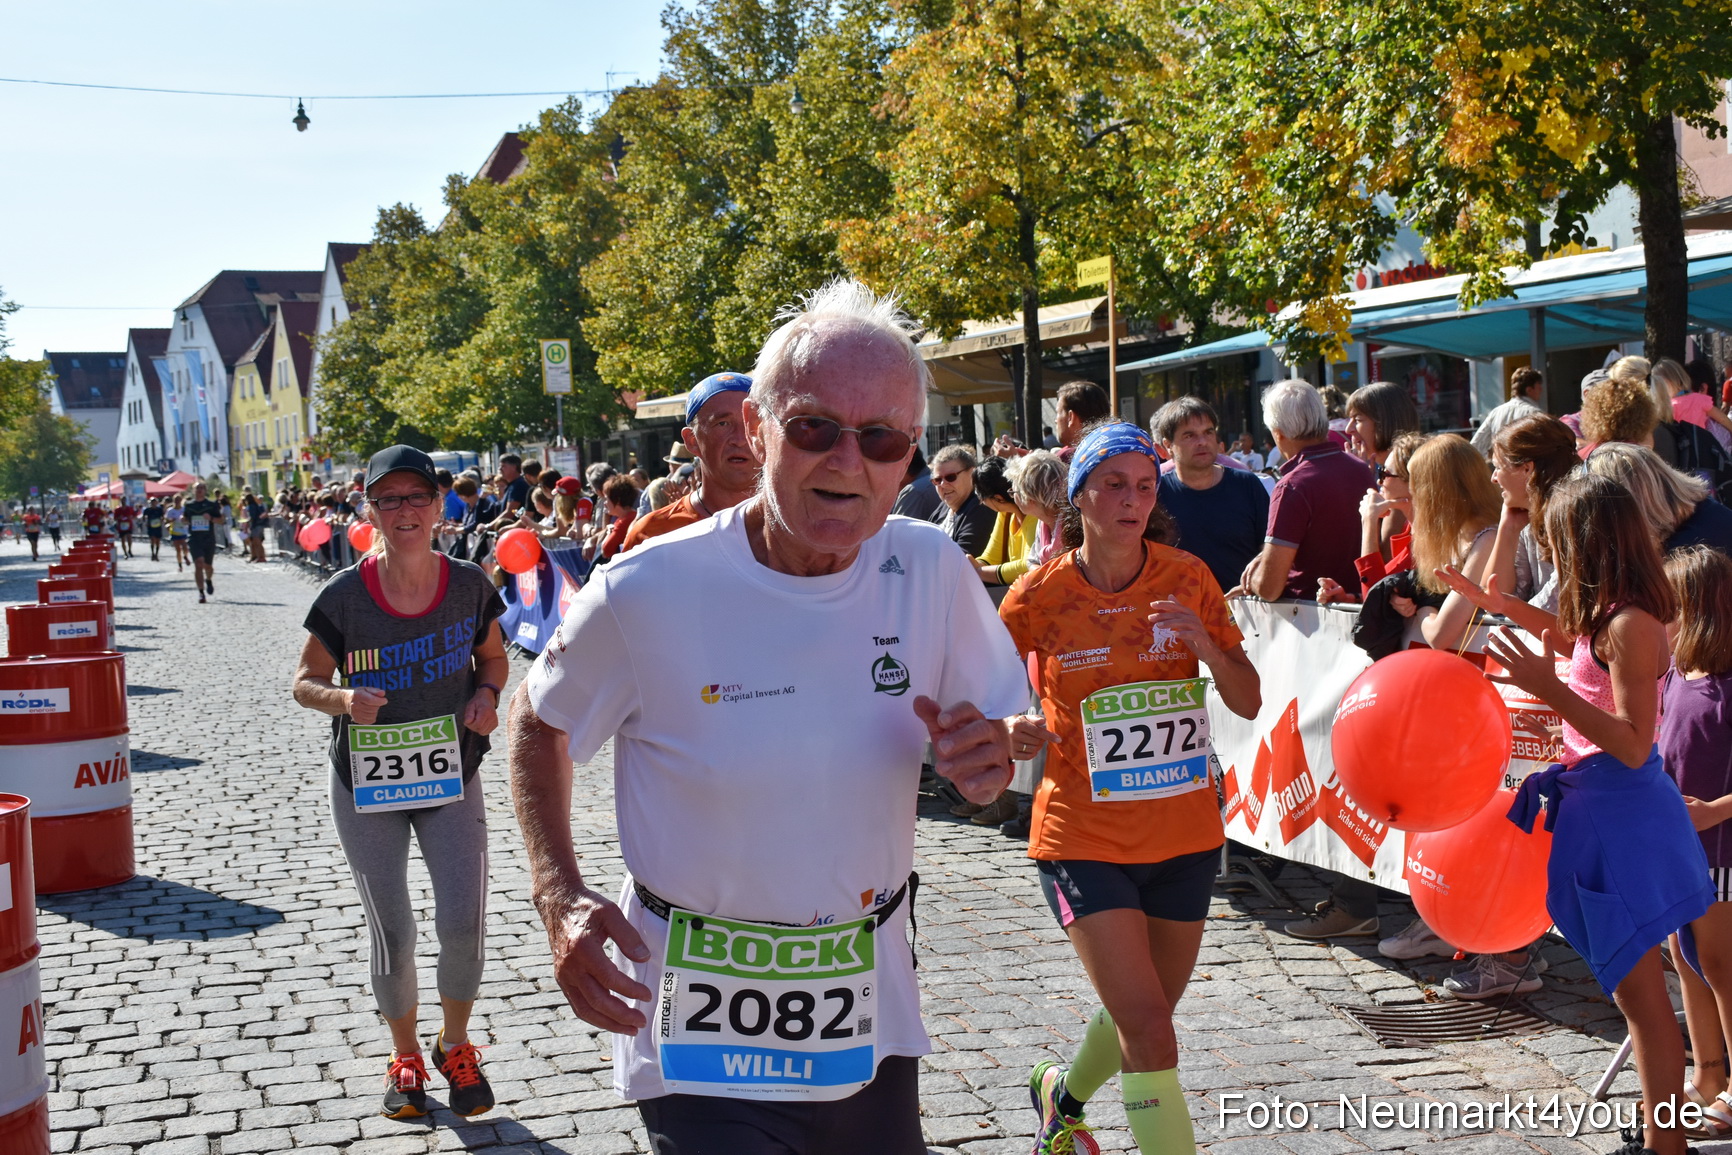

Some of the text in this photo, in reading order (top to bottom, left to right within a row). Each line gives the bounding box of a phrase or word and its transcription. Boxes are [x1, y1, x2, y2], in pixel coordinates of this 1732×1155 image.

[1084, 266, 1109, 278] Toiletten
[380, 633, 436, 669] START
[444, 615, 477, 650] EAS
[873, 636, 900, 646] Team
[1061, 656, 1107, 668] WOHLLEBEN
[1064, 647, 1111, 660] INTERSPORT
[879, 669, 905, 680] HANSE
[722, 684, 743, 693] MTV
[723, 686, 795, 703] Capital Invest AG
[1093, 683, 1196, 718] BOCK
[1341, 700, 1376, 721] energie
[358, 722, 447, 746] BOCK
[1102, 717, 1197, 763] 2272
[363, 748, 449, 781] 2316
[1121, 764, 1190, 787] BIANKA
[373, 784, 444, 802] CLAUDIA
[1272, 771, 1313, 823] Braun
[1338, 809, 1380, 853] Sicher ist sicher
[1420, 878, 1449, 896] energie
[814, 914, 835, 926] AG
[684, 922, 862, 972] BOCK
[685, 983, 854, 1040] 2082
[722, 1053, 813, 1079] WILLI
